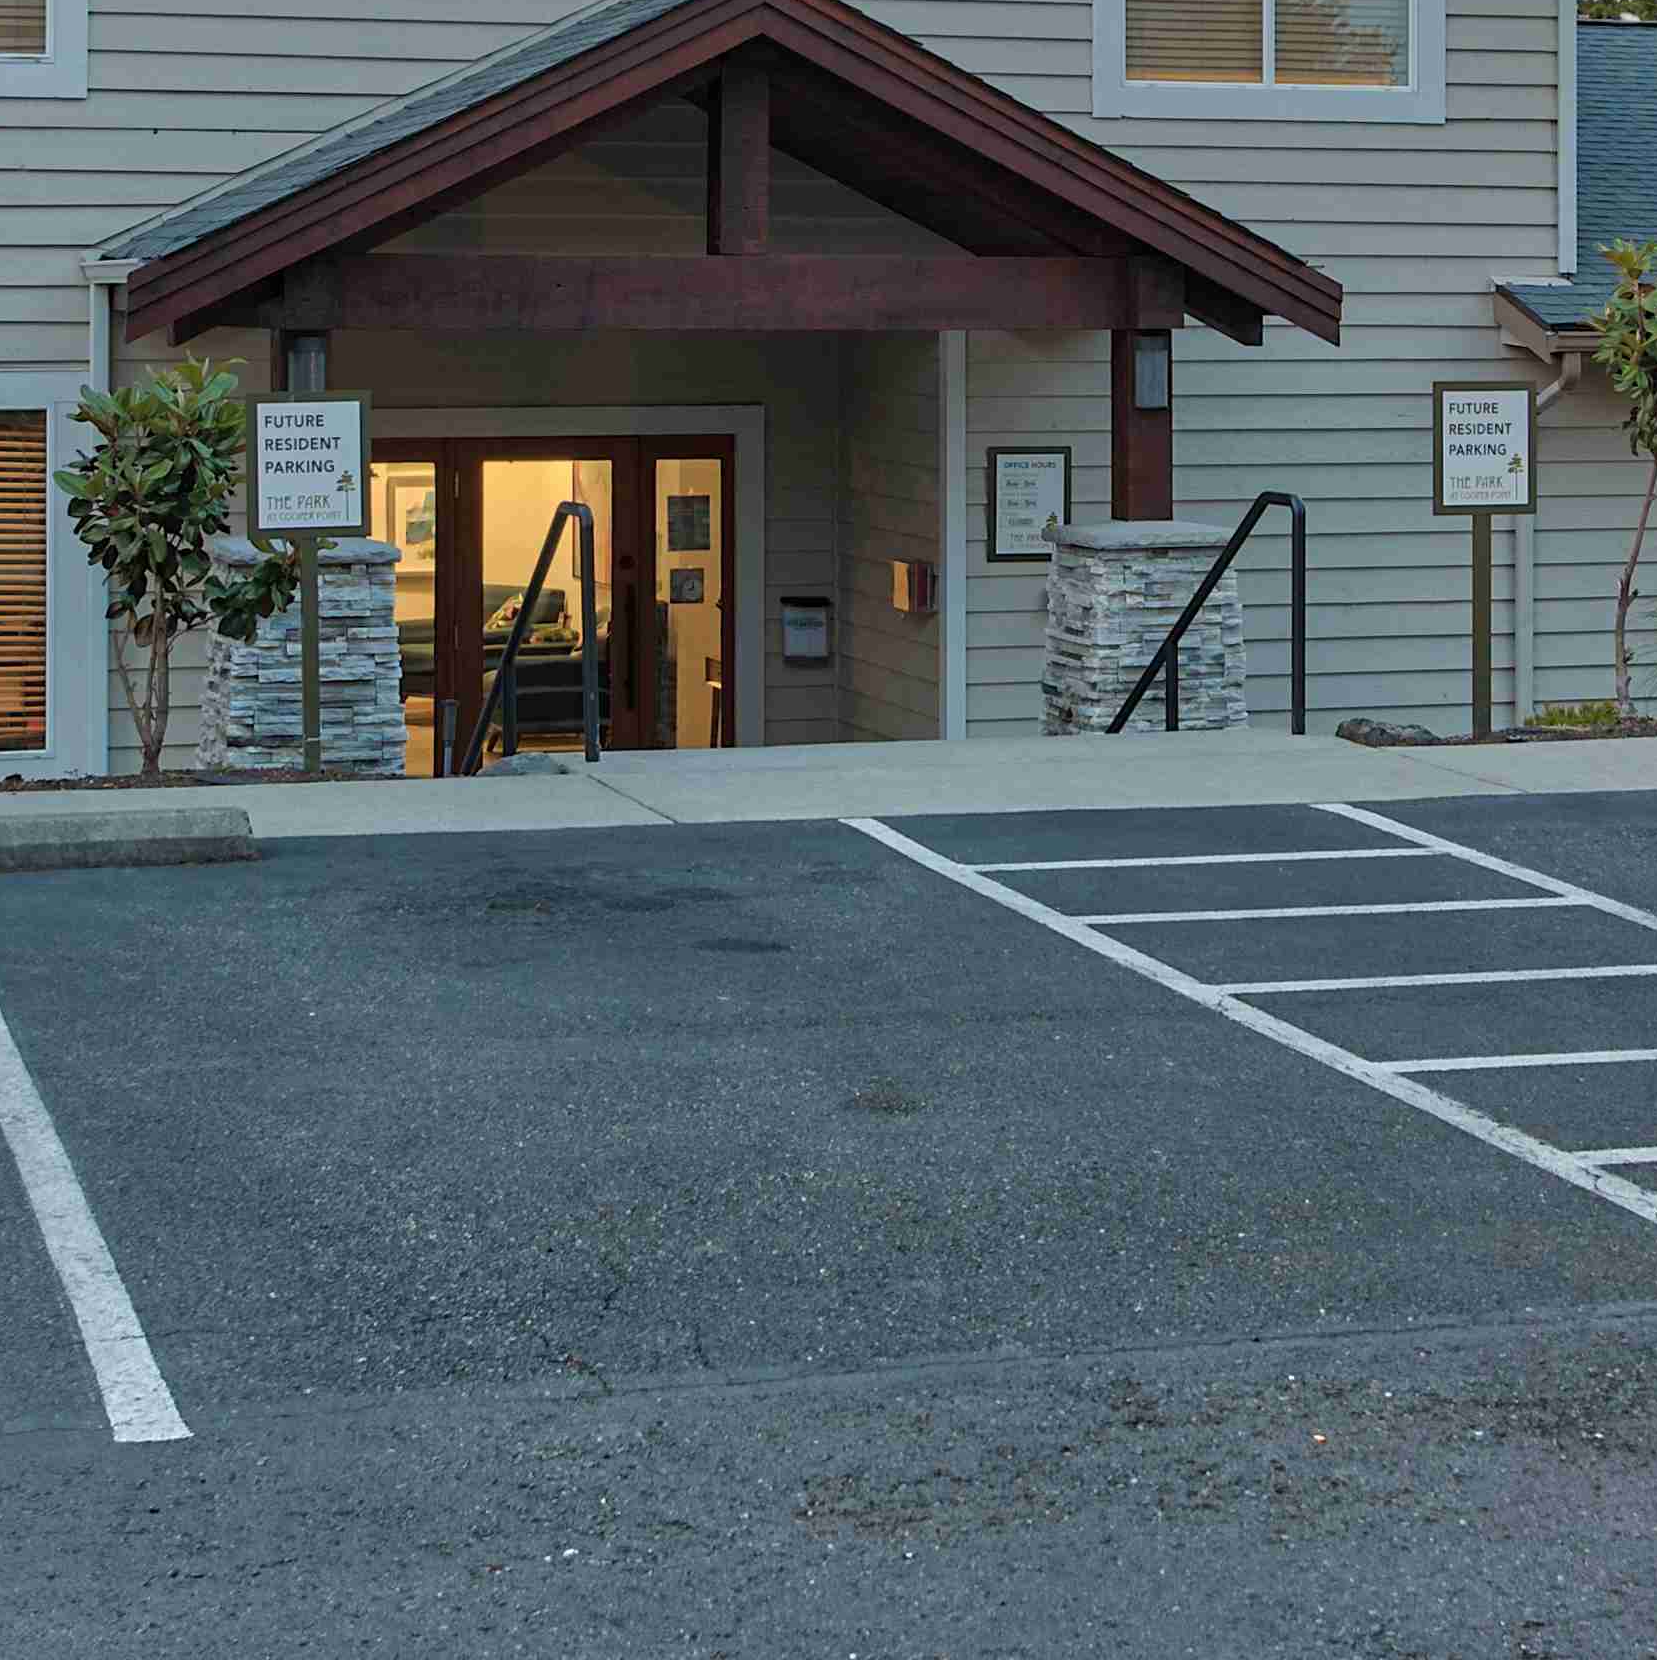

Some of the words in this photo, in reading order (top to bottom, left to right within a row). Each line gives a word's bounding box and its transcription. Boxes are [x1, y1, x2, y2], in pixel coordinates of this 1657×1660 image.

[1449, 402, 1499, 415] FUTURE
[264, 414, 325, 428] FUTURE
[1449, 422, 1512, 436] RESIDENT
[264, 437, 342, 453] RESIDENT
[1449, 443, 1507, 456] PARKING
[265, 459, 335, 474] PARKING
[1450, 476, 1471, 489] THE
[1476, 476, 1503, 489] PARK
[267, 496, 292, 510] THE
[297, 494, 331, 510] PARK
